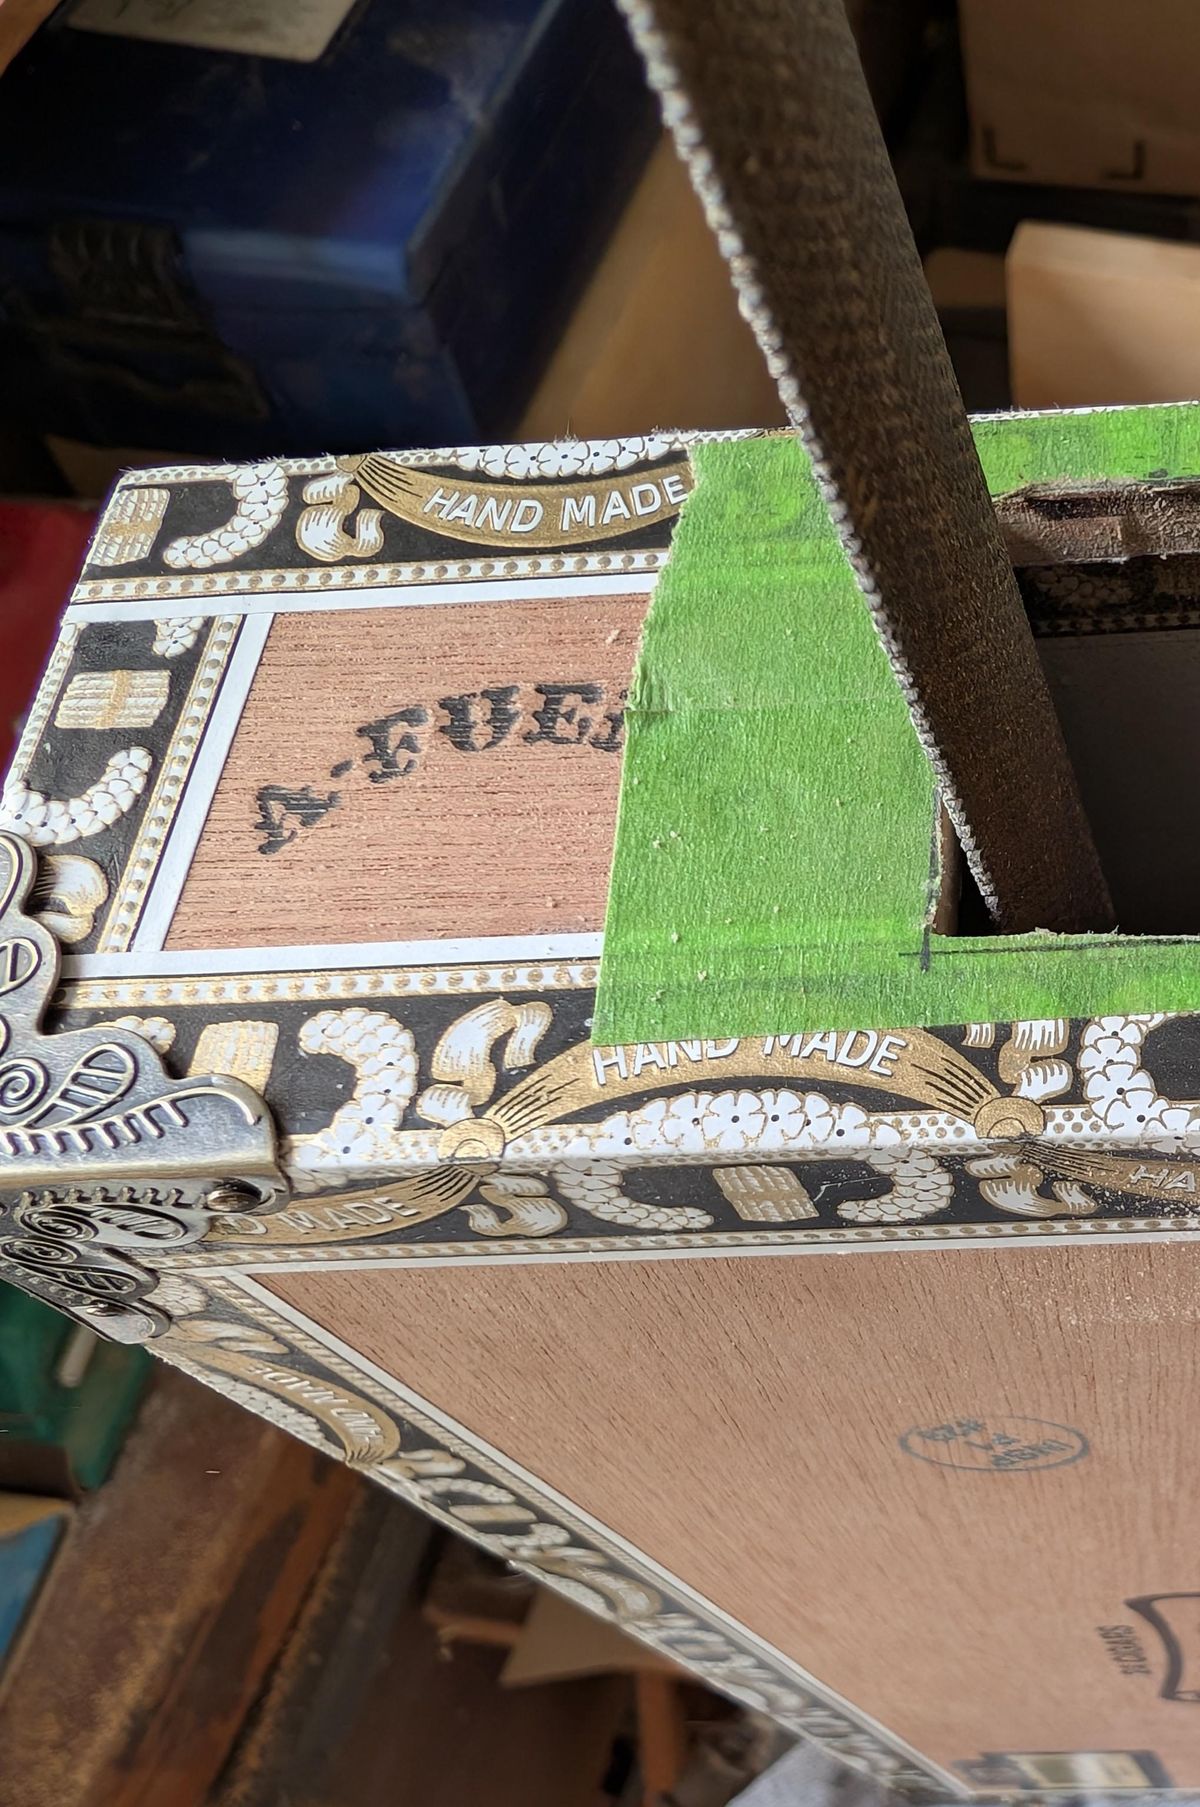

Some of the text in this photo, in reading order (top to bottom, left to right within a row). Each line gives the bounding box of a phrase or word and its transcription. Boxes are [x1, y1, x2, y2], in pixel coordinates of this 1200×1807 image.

[423, 474, 692, 533] HAND MADE
[278, 1196, 421, 1235] MADE
